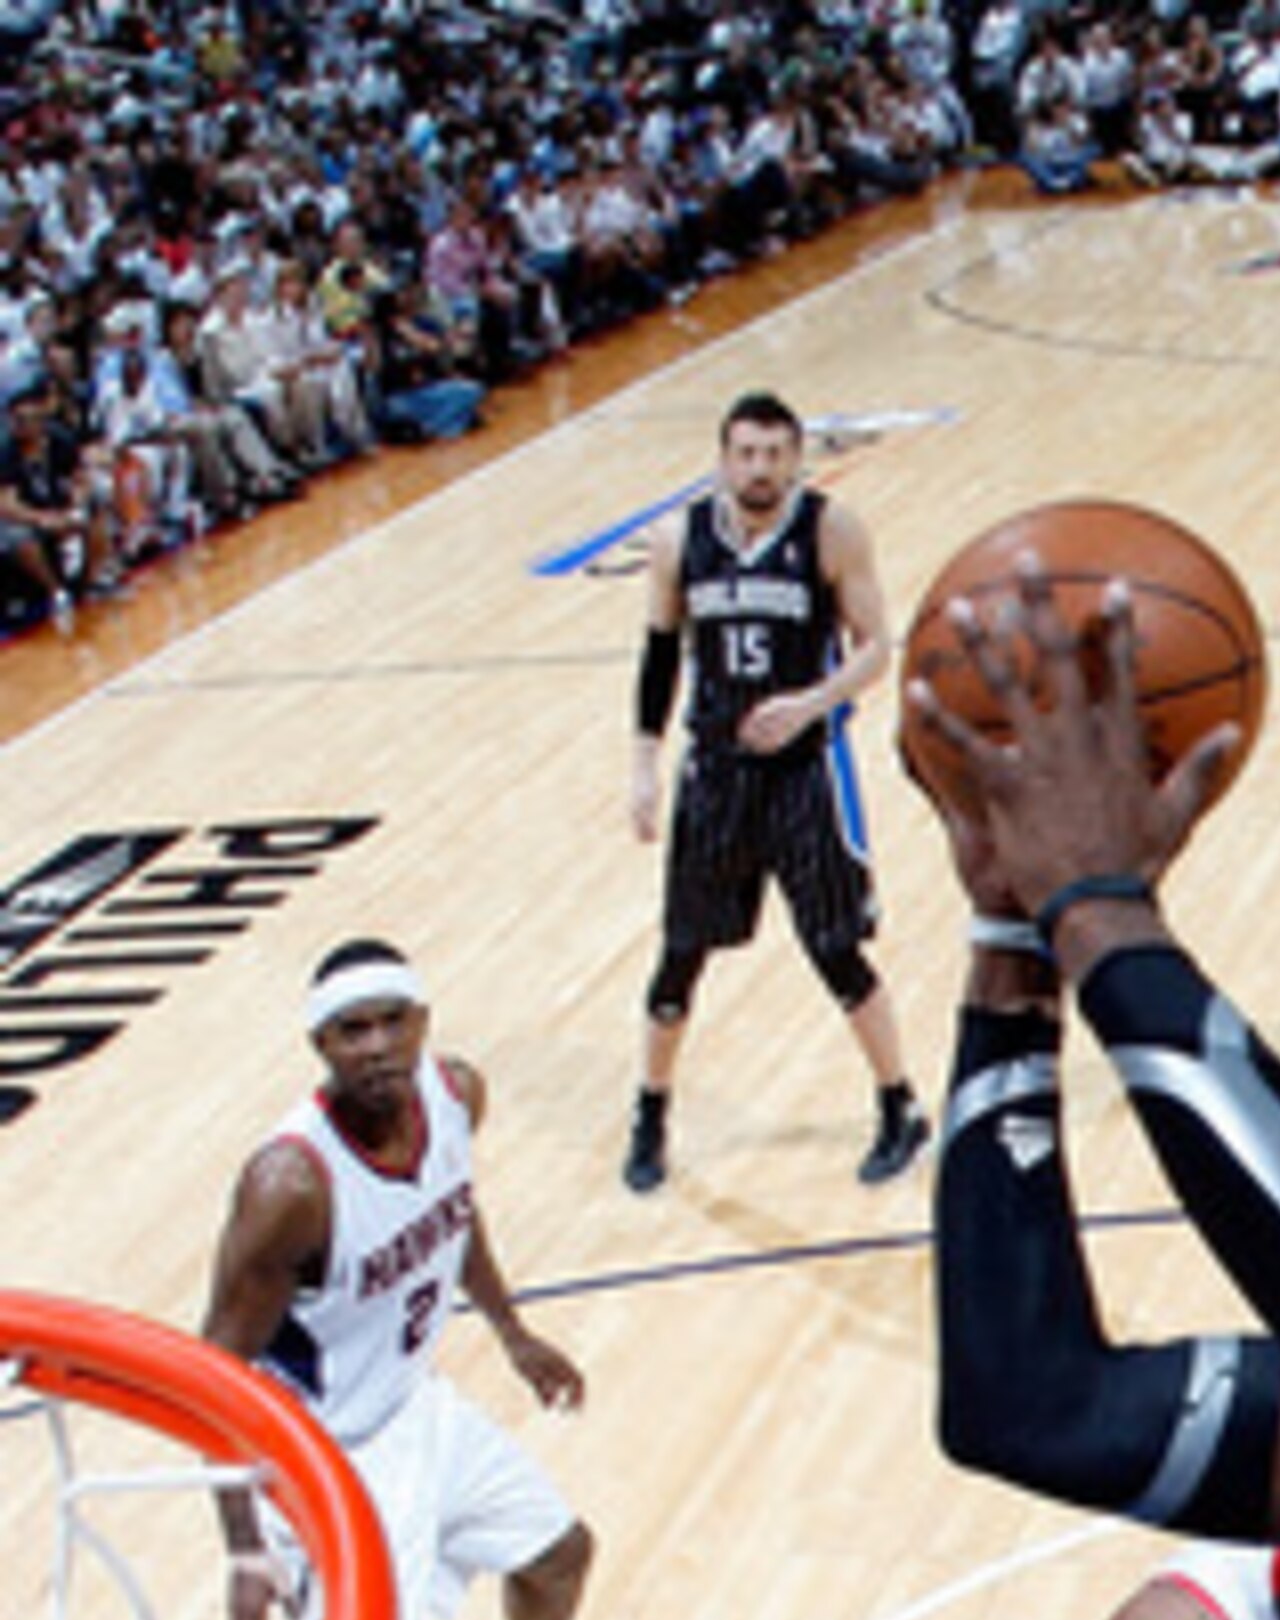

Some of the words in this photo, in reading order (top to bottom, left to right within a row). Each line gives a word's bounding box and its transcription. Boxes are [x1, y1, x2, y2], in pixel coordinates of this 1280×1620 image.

[722, 622, 772, 676] 15
[0, 815, 384, 1126] PHILIP
[403, 1279, 439, 1355] 2
